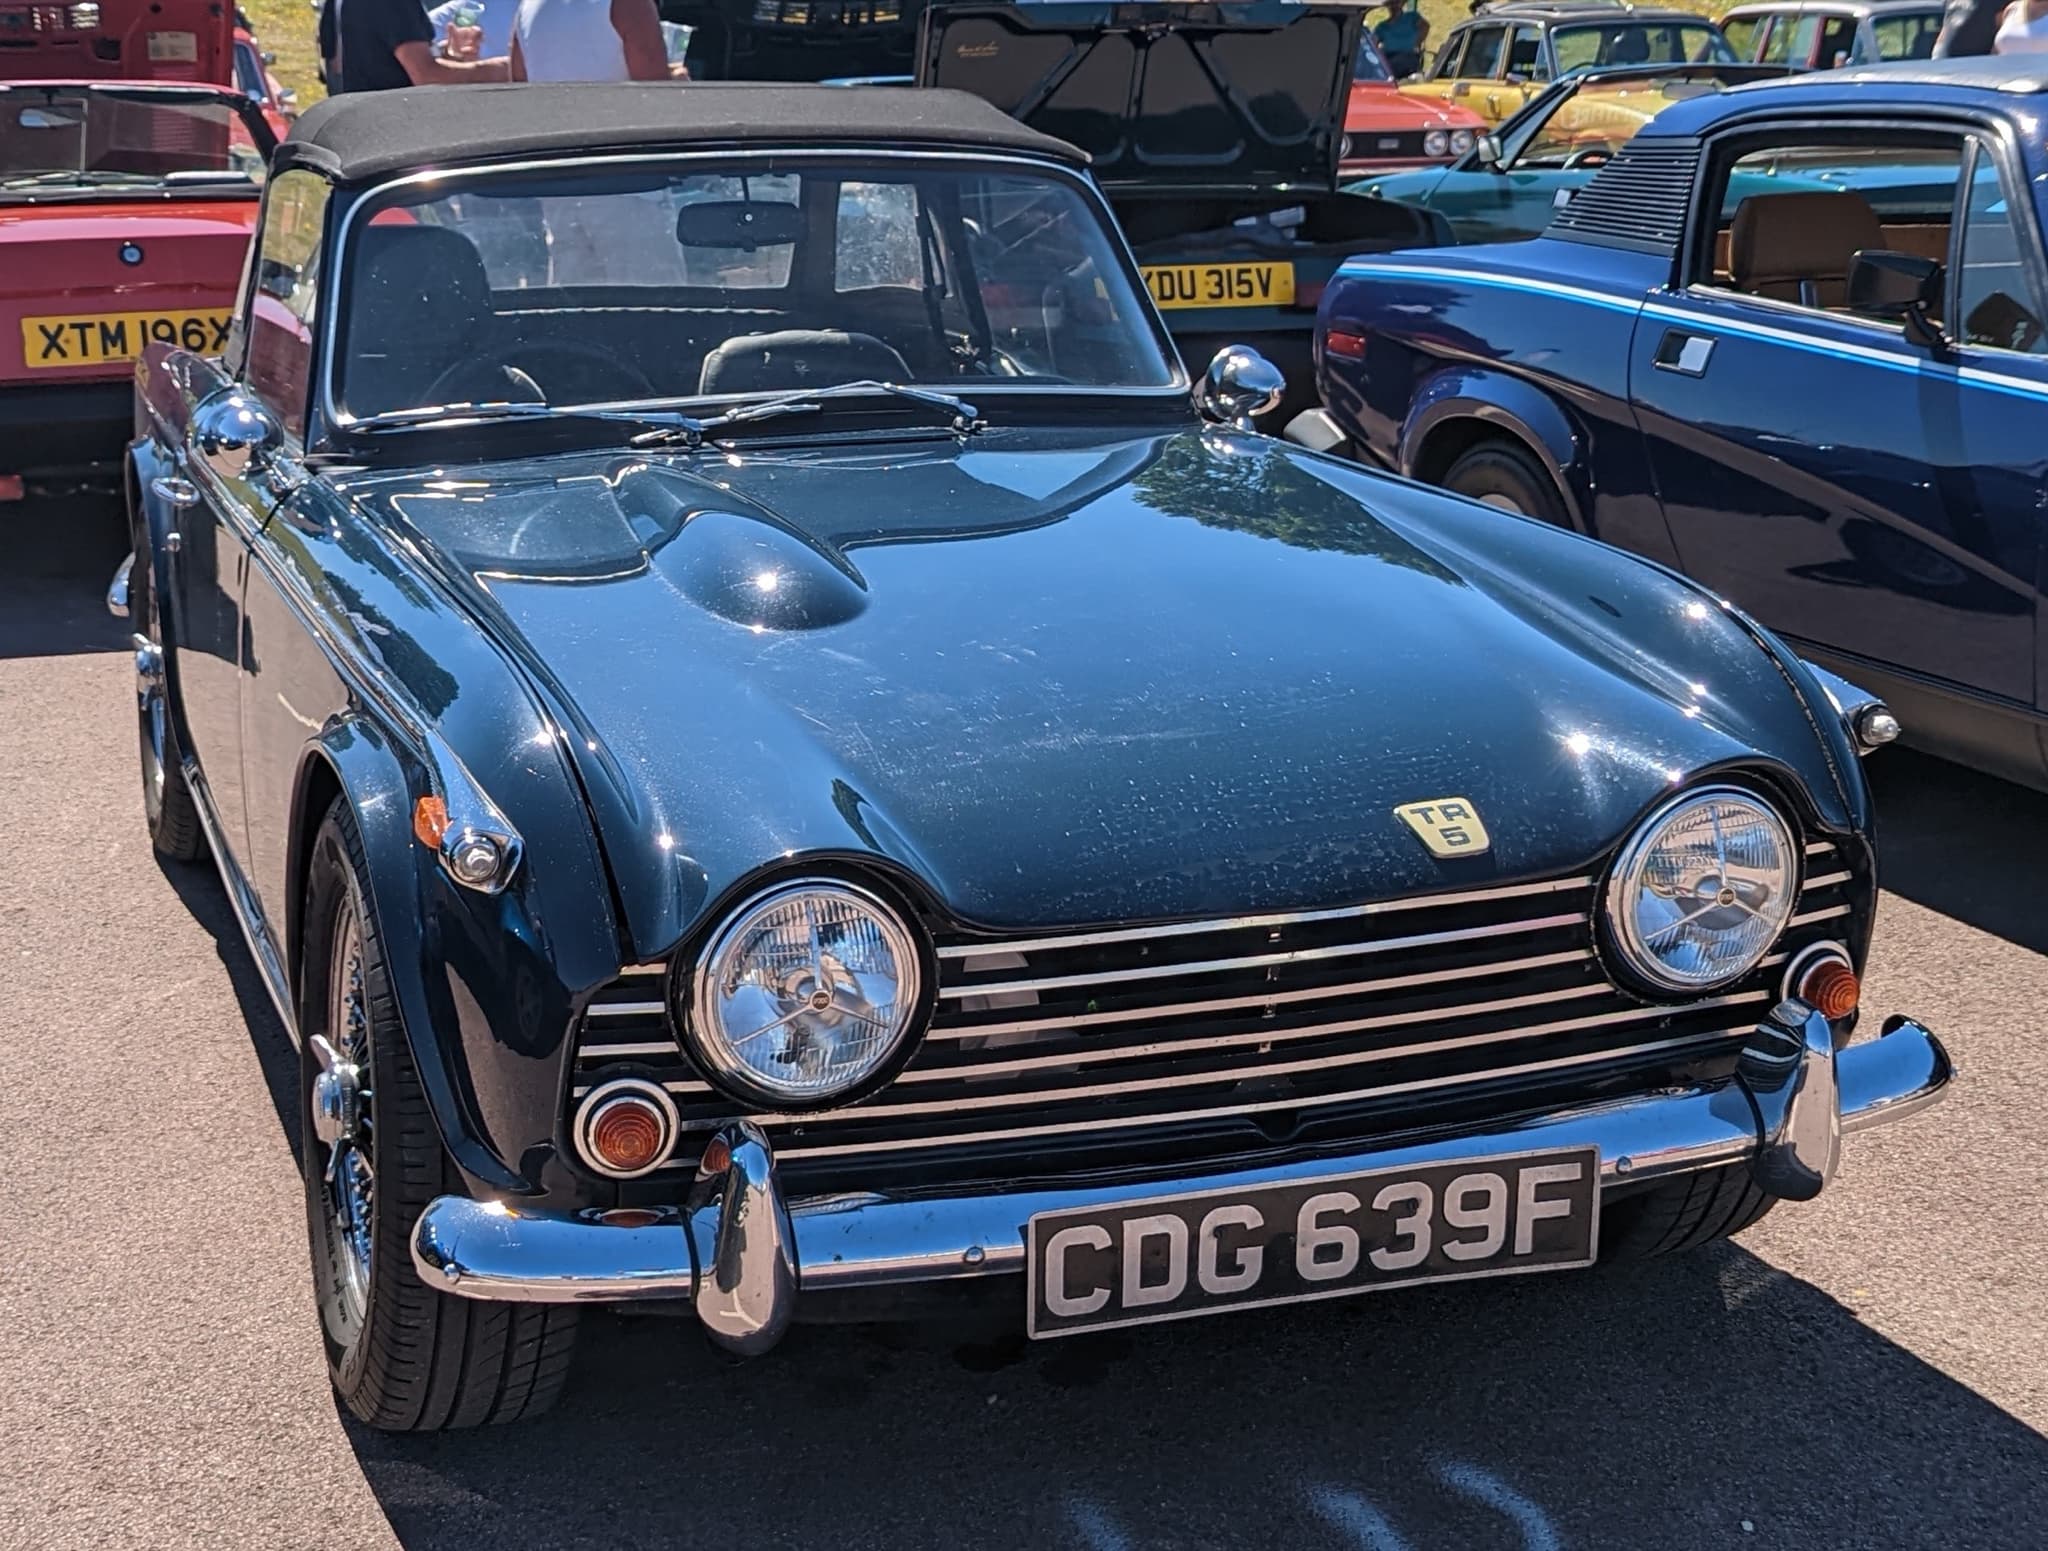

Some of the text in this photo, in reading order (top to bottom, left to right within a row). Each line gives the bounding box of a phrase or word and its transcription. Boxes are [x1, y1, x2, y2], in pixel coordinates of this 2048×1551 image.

[1205, 267, 1272, 300] 315V
[38, 315, 232, 359] XTM 196X
[1407, 803, 1472, 825] TR
[1438, 825, 1472, 847] 5
[1044, 1162, 1583, 1318] CDG 639F
